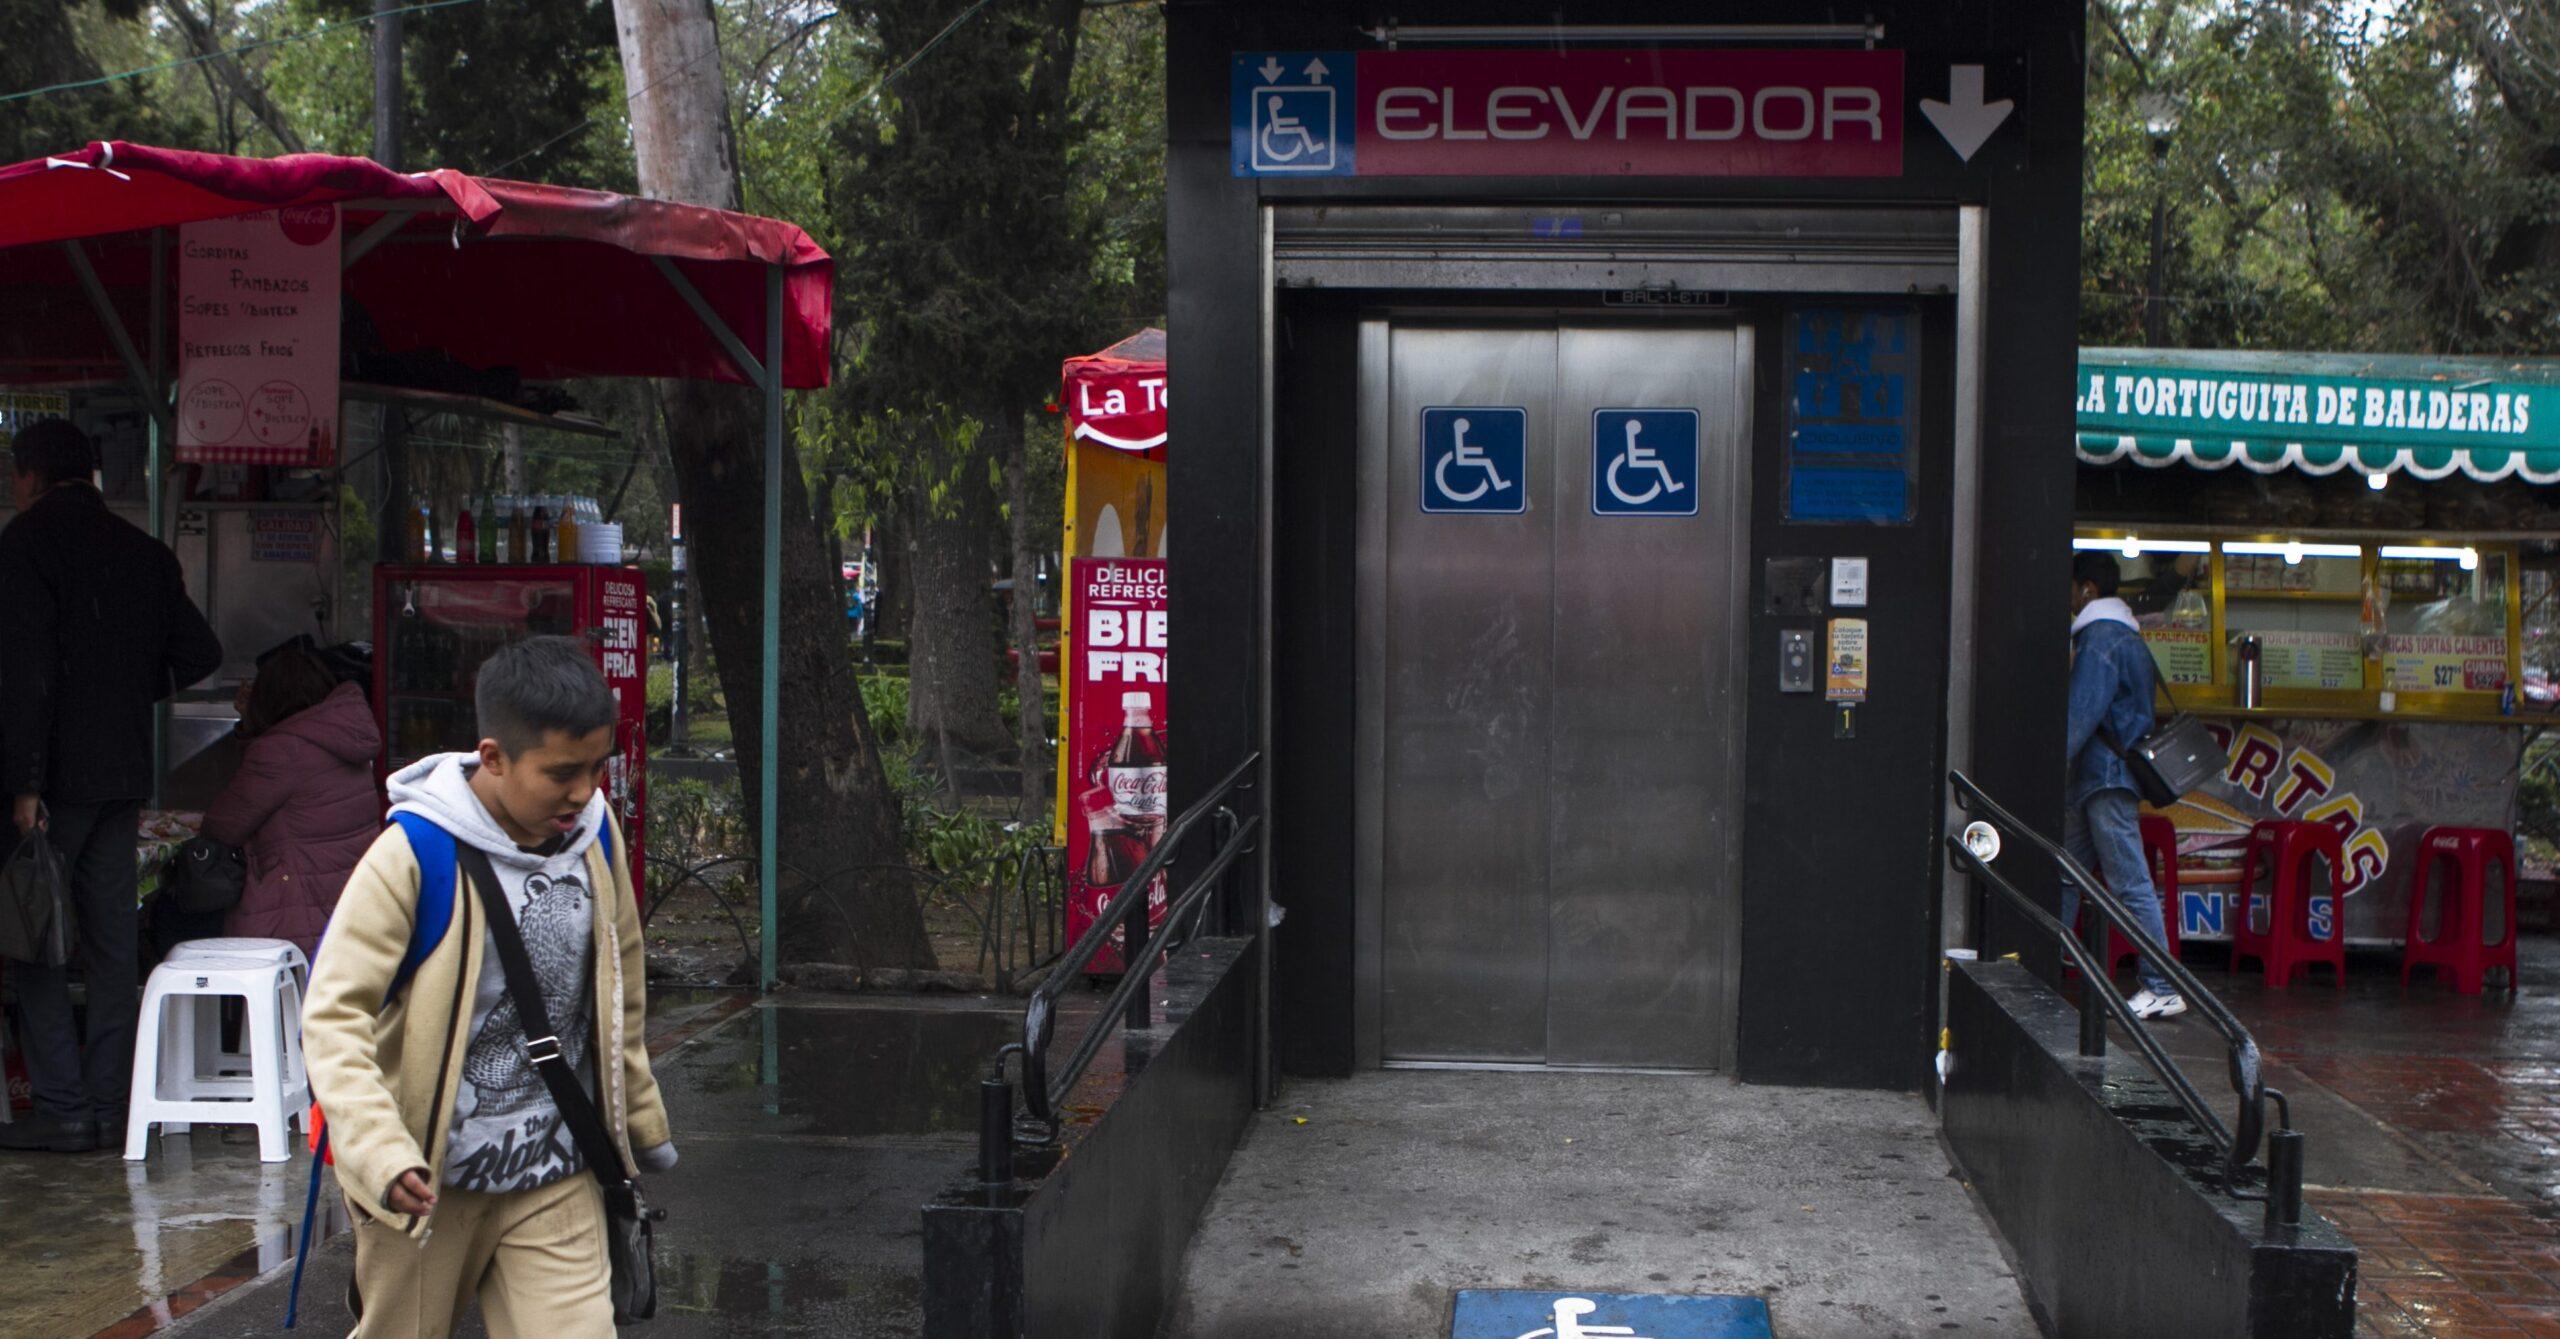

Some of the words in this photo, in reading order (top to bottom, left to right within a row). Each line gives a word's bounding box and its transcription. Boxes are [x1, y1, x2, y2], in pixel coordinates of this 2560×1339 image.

[1375, 85, 1884, 141] ELEVADOR
[184, 240, 249, 261] GORDITAS
[229, 268, 310, 293] PAMBAZOS
[184, 295, 231, 317] SOPES
[184, 341, 252, 359] REFRESCOS
[1081, 384, 1127, 416] La
[2114, 375, 2309, 424] TORTUGUITA
[2315, 385, 2358, 426] DE
[2362, 388, 2530, 433] BALDERAS
[1096, 567, 1165, 584] DELICI
[604, 581, 636, 596] DELICIOSA
[1088, 583, 1168, 599] REFRESC
[603, 617, 638, 649] BIEN
[1088, 609, 1168, 648] BIE
[2417, 636, 2452, 655] TORTAS
[2454, 637, 2506, 656] CALIENTES
[2465, 660, 2507, 673] CUBANA
[1842, 709, 1850, 729] 1
[524, 1115, 549, 1138] the
